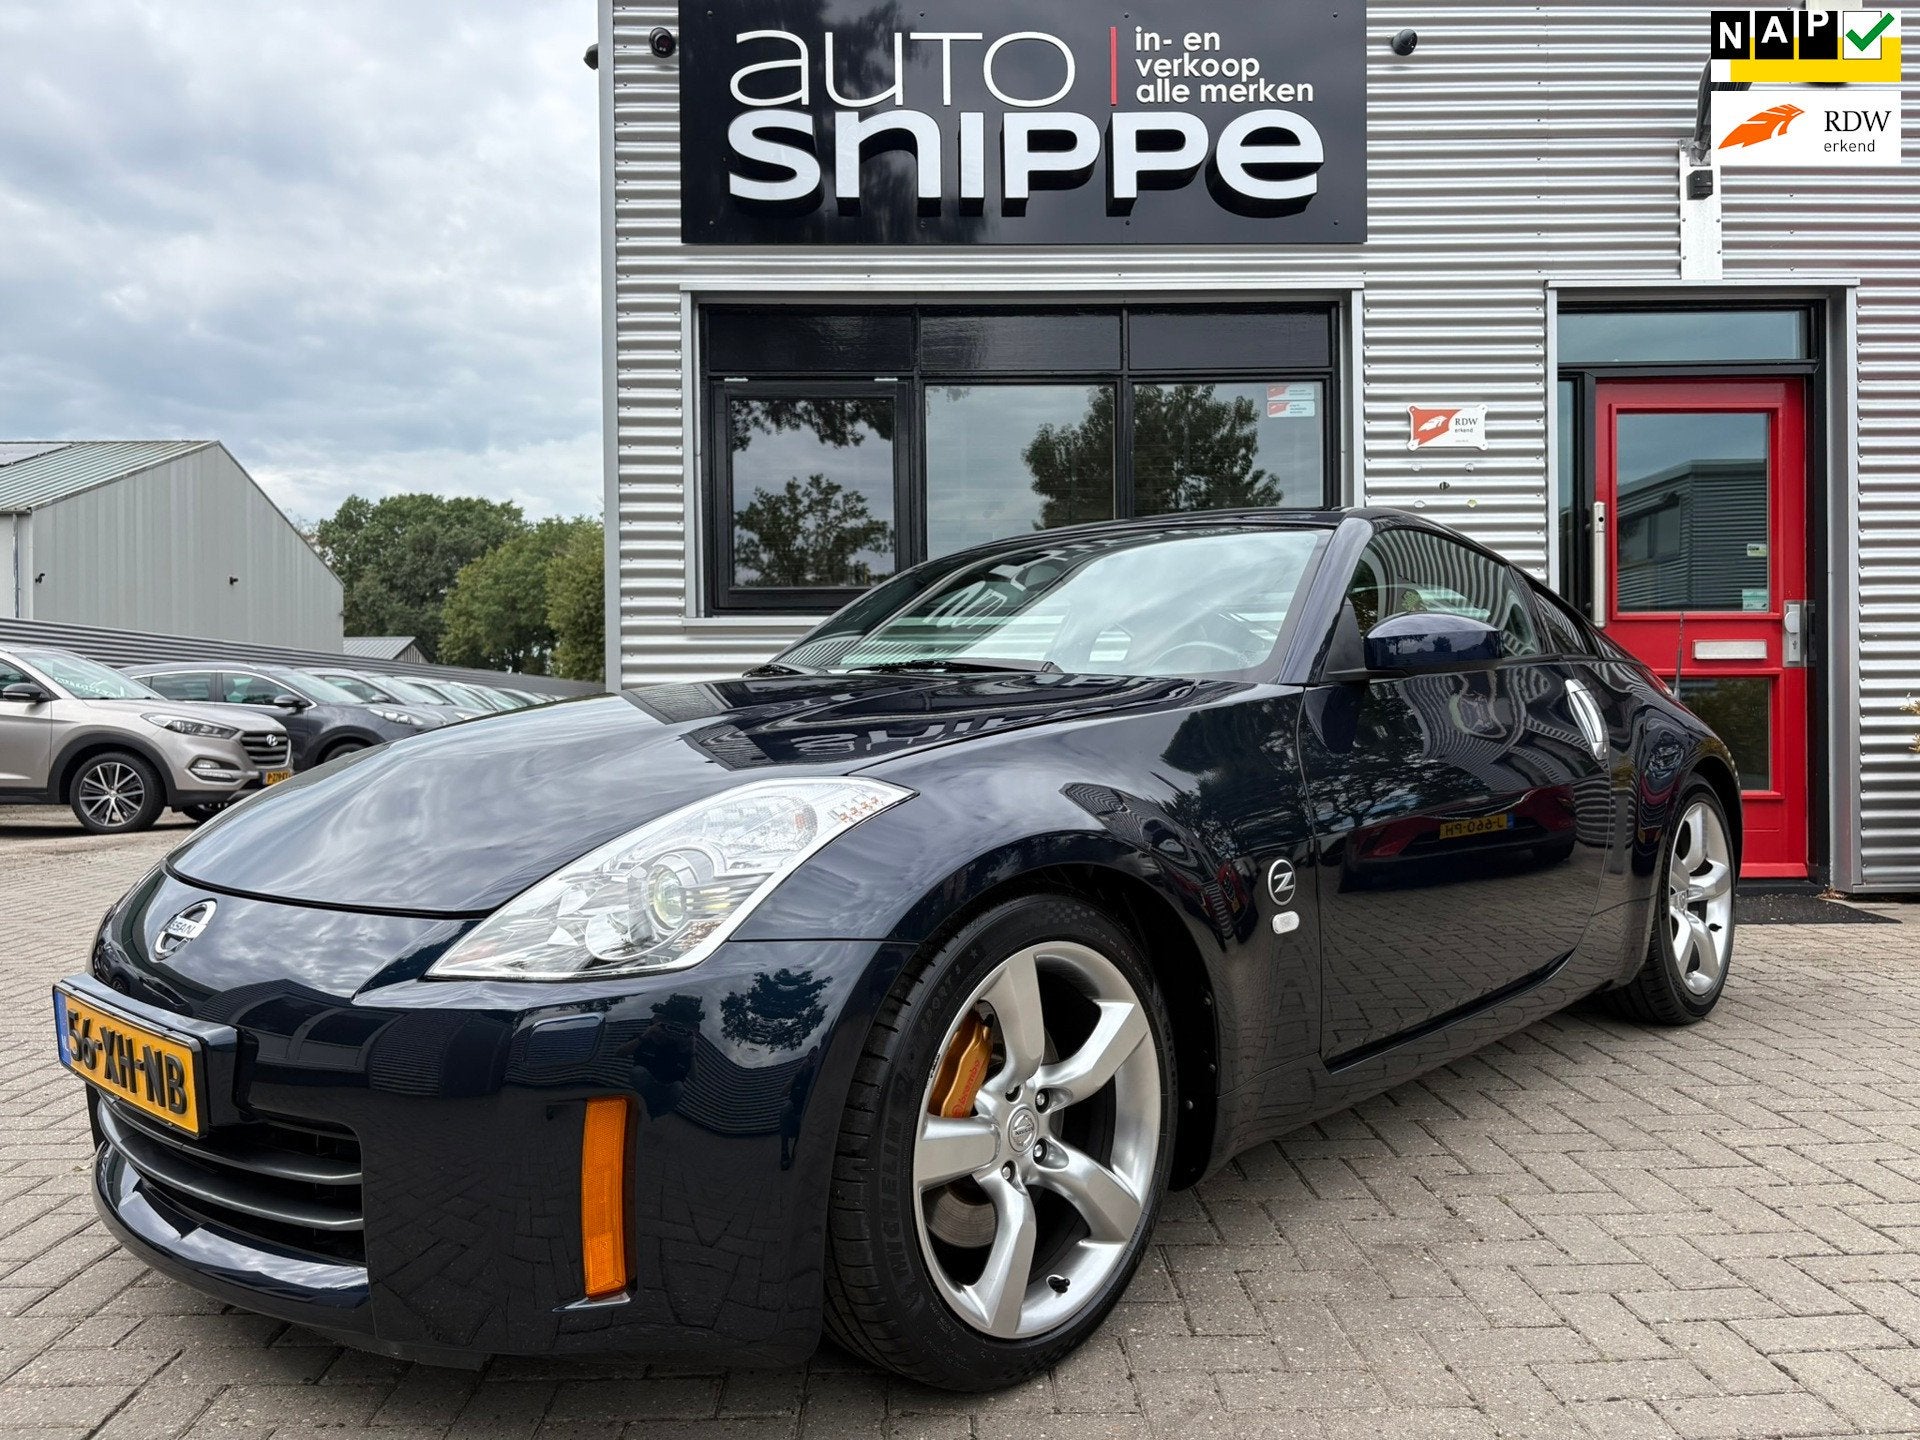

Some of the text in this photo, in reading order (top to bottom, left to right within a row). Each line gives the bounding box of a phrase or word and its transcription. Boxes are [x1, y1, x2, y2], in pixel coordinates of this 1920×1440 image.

[1135, 26, 1221, 52] in- en
[1135, 52, 1261, 79] verkoop
[1135, 78, 1314, 104] alle merken
[1454, 417, 1479, 426] RDW
[66, 1008, 188, 1115] 56-XH-NB
[959, 1060, 982, 1106] brembo
